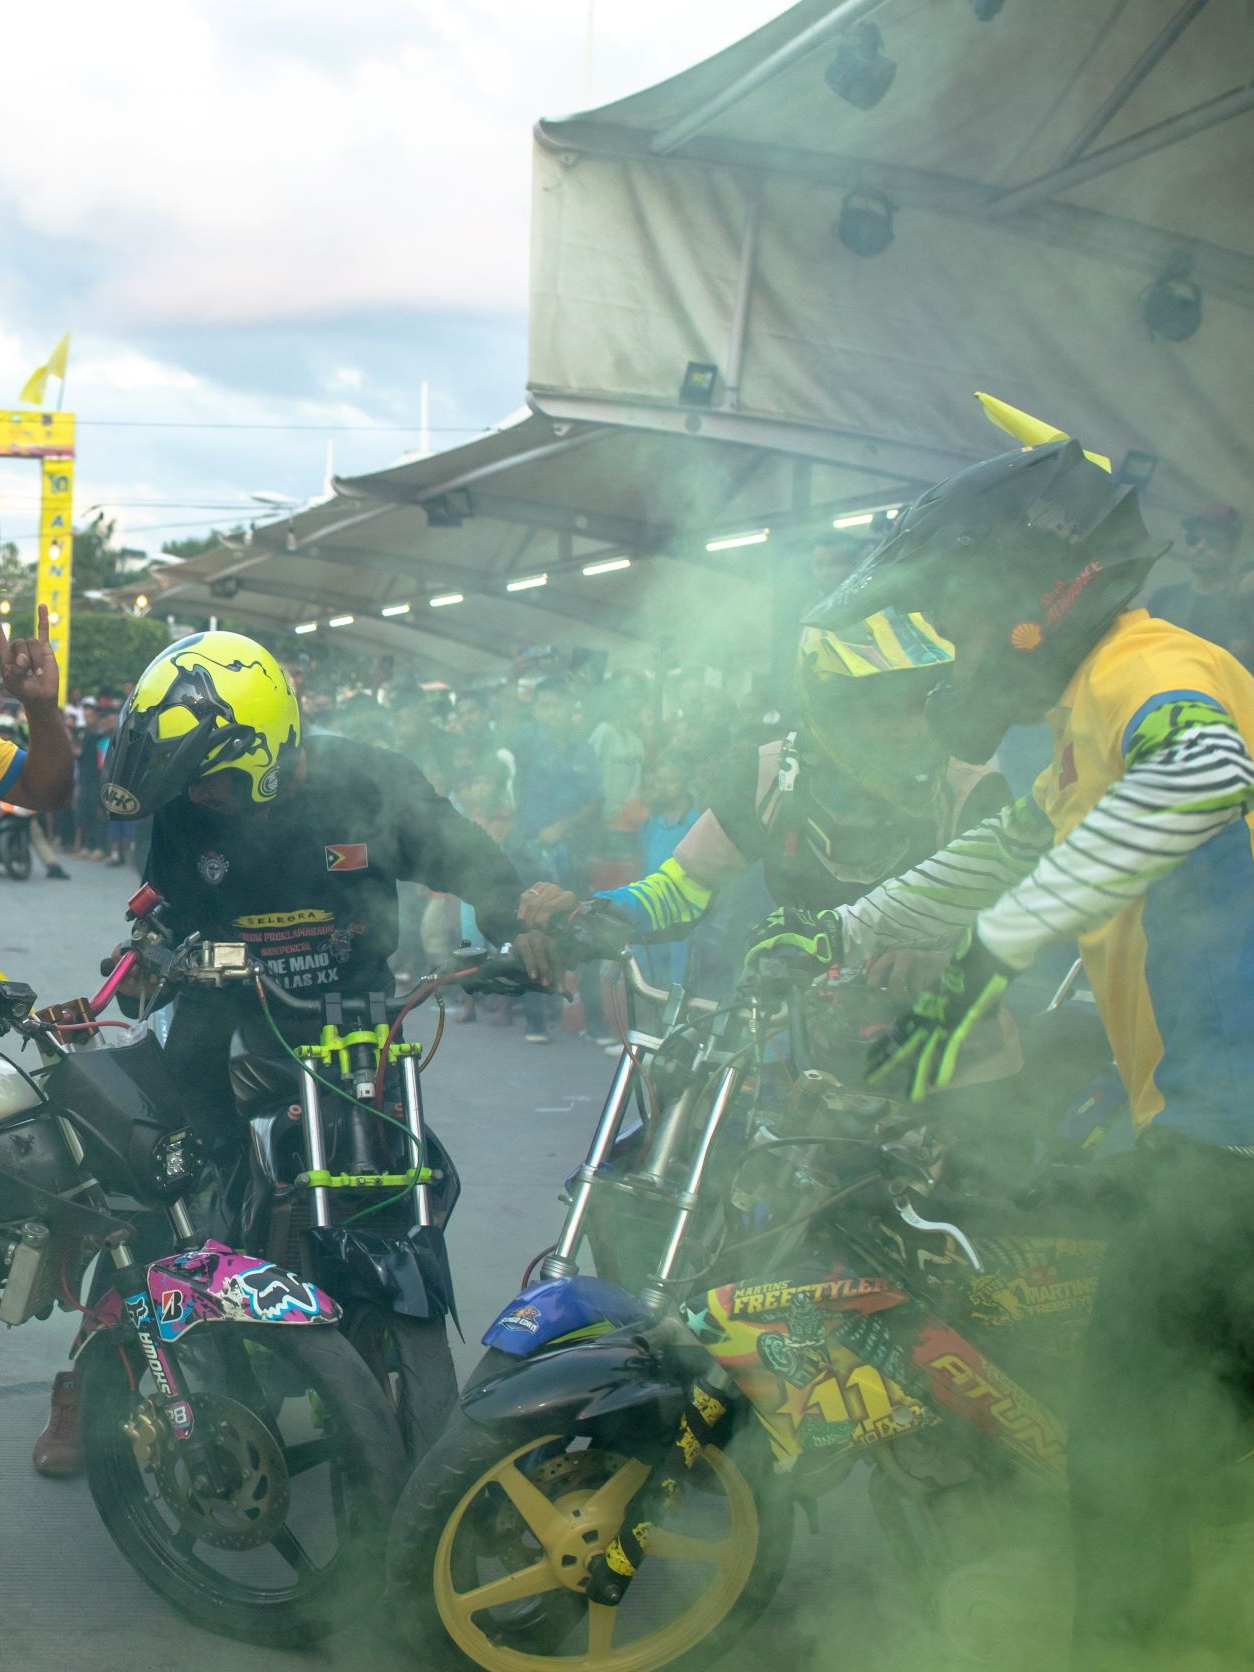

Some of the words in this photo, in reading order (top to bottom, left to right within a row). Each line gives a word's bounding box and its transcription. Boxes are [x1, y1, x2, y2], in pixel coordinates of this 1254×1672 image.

[102, 785, 133, 810] NHK
[289, 953, 330, 972] MAIO
[317, 968, 339, 985] XX
[734, 1279, 792, 1298] MARTINS
[139, 1332, 171, 1396] SHOWA
[929, 1354, 1067, 1472] ATUN
